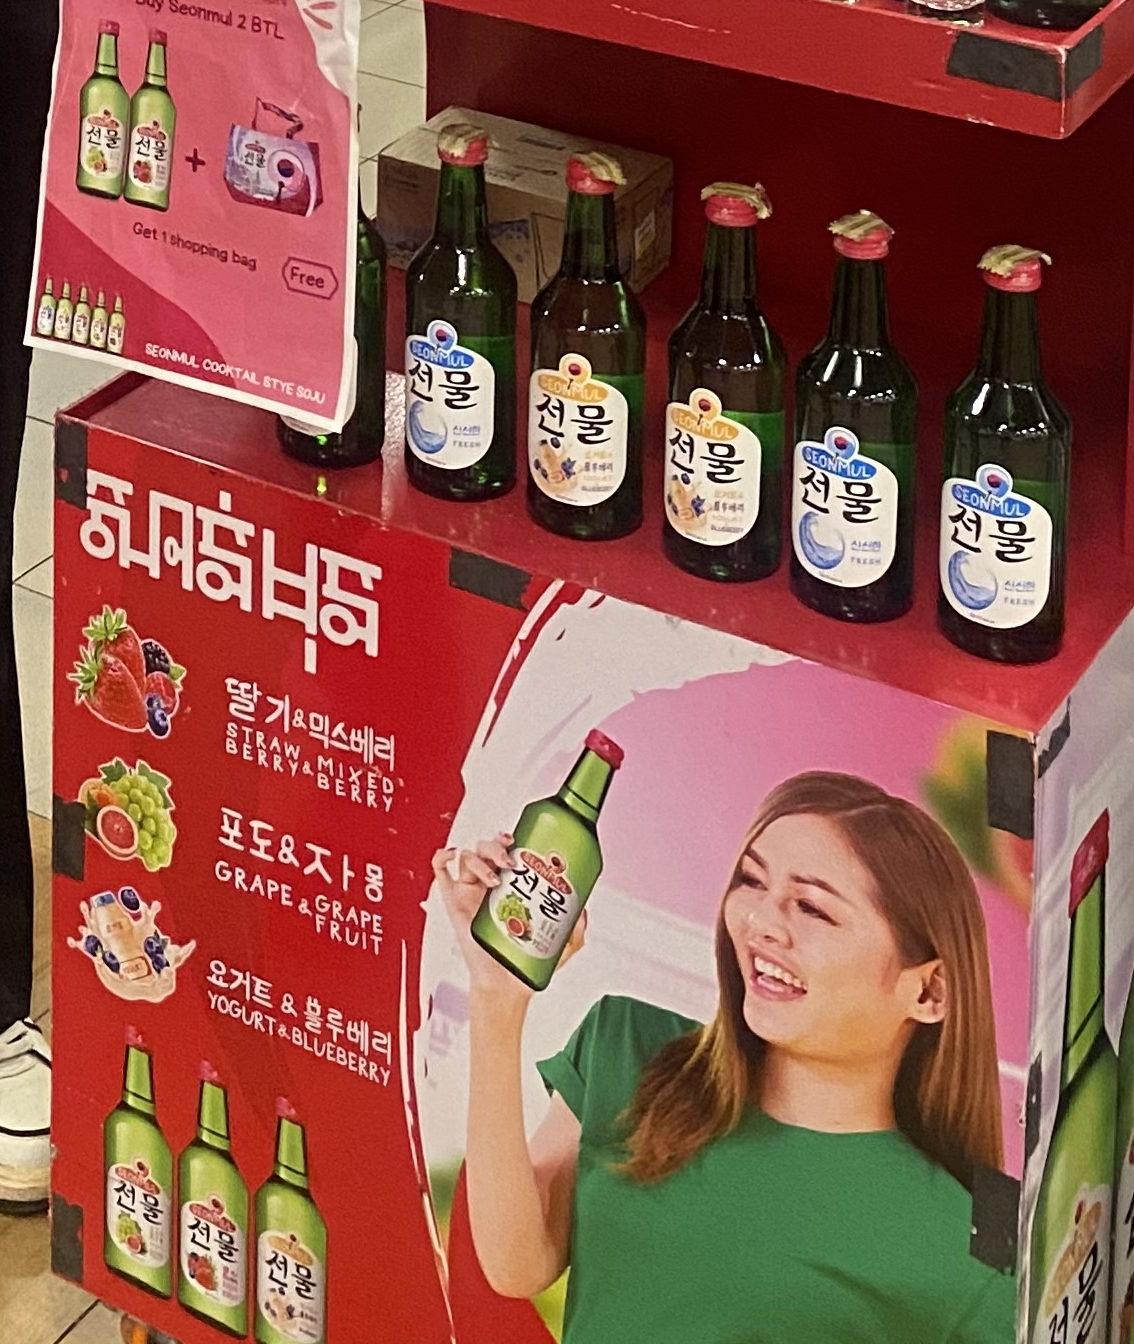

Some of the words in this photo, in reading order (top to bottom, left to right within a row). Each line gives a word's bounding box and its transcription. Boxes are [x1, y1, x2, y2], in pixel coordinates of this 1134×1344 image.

[237, 14, 247, 30] 2
[251, 16, 286, 40] BTL
[133, 222, 158, 243] Get
[170, 233, 229, 263] shopping
[232, 249, 258, 272] bag
[290, 266, 325, 289] Free
[145, 342, 200, 369] SEONMUL
[263, 375, 295, 395] STYE
[296, 385, 326, 405] SOJU
[408, 357, 480, 410] 선물
[535, 392, 614, 445] 선물
[669, 427, 745, 485] 선물
[805, 448, 872, 478] SEONMUL
[799, 465, 883, 524] 선물
[954, 484, 1027, 517] SEONMUL
[948, 503, 1036, 563] 선물
[225, 738, 299, 777] BERRY
[226, 722, 301, 760] STRAW
[317, 755, 394, 794] MIXED
[317, 772, 393, 813] BERRY
[214, 860, 294, 907] GRAPE
[315, 894, 384, 934] GRAPE
[315, 913, 383, 955] FRUIT
[206, 960, 273, 1009] 요거트
[280, 993, 298, 1017] &
[207, 990, 277, 1037] YOGURT
[292, 1026, 391, 1087] BLUEBERRY
[112, 1182, 165, 1227] 선물
[187, 1216, 240, 1264] 선물
[264, 1250, 318, 1301] 선물
